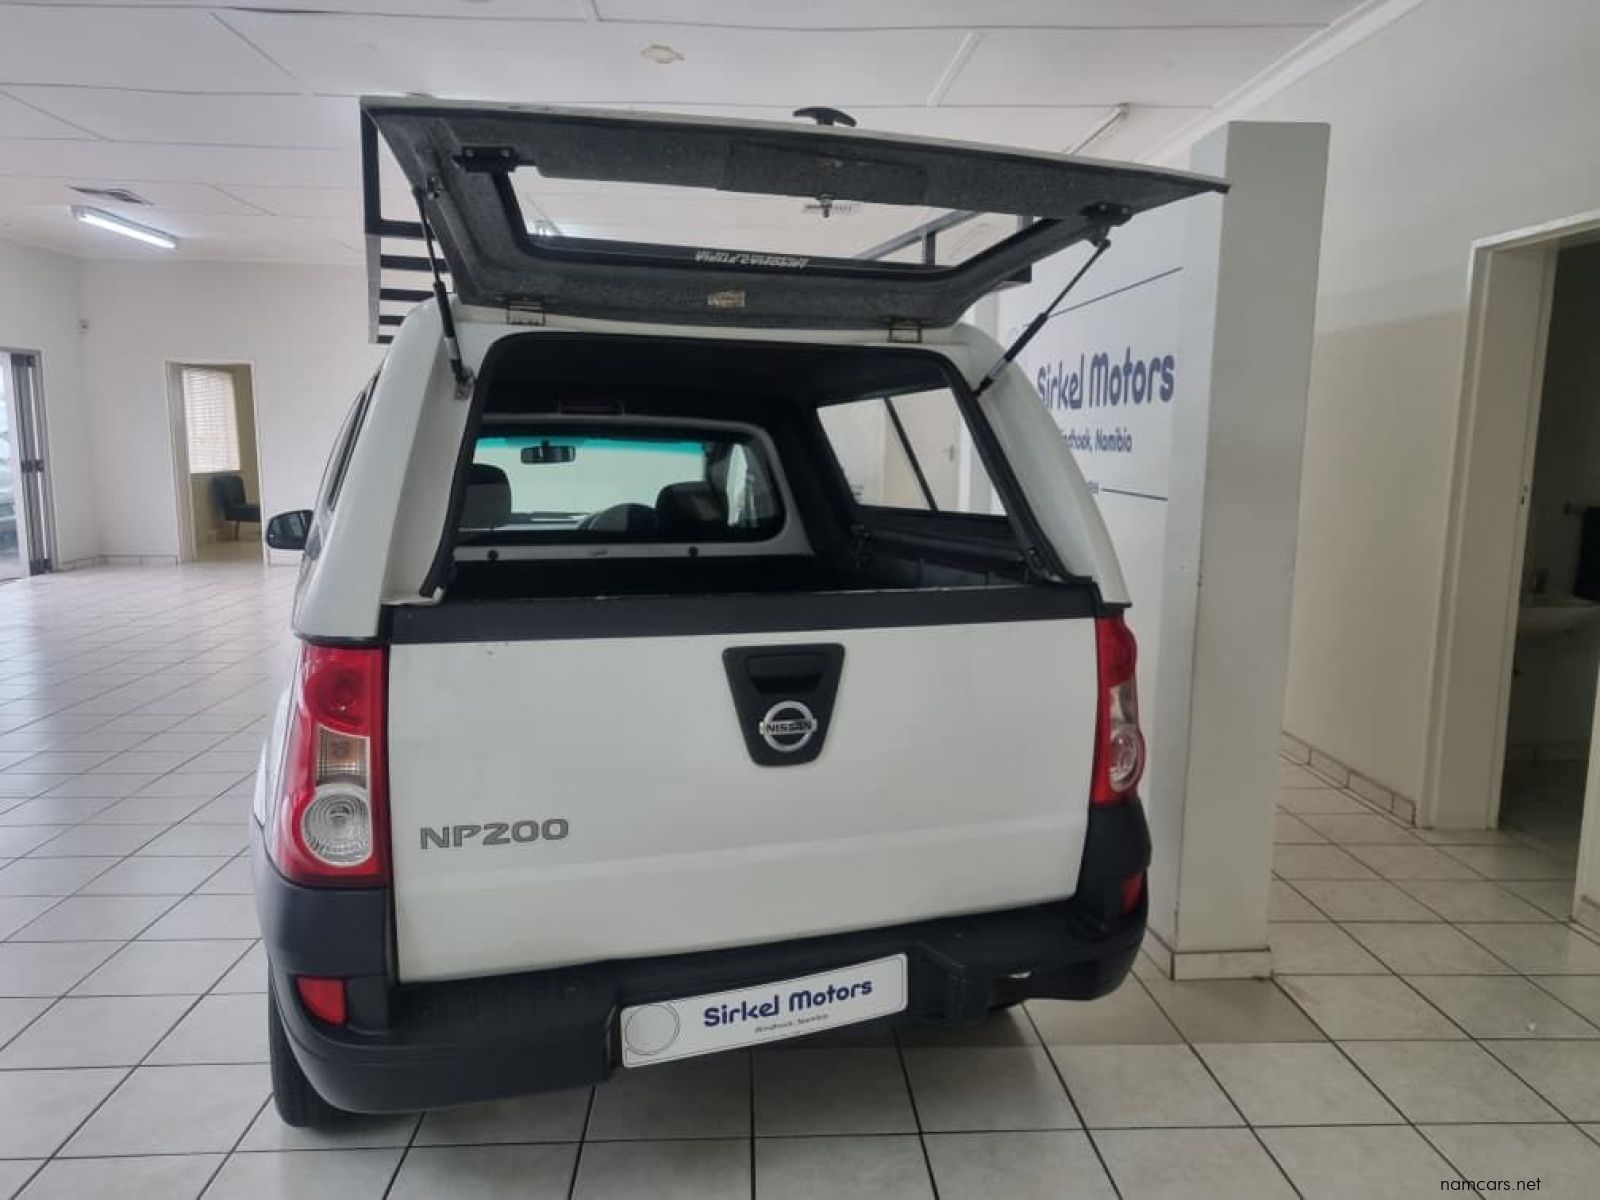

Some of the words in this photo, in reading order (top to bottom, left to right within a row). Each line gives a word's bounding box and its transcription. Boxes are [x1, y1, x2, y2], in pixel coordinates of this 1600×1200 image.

[1037, 354, 1084, 410] Sirkel
[1089, 346, 1175, 408] Motors
[420, 818, 569, 850] NP200
[703, 994, 779, 1027] Sirkel
[788, 980, 873, 1013] Motors
